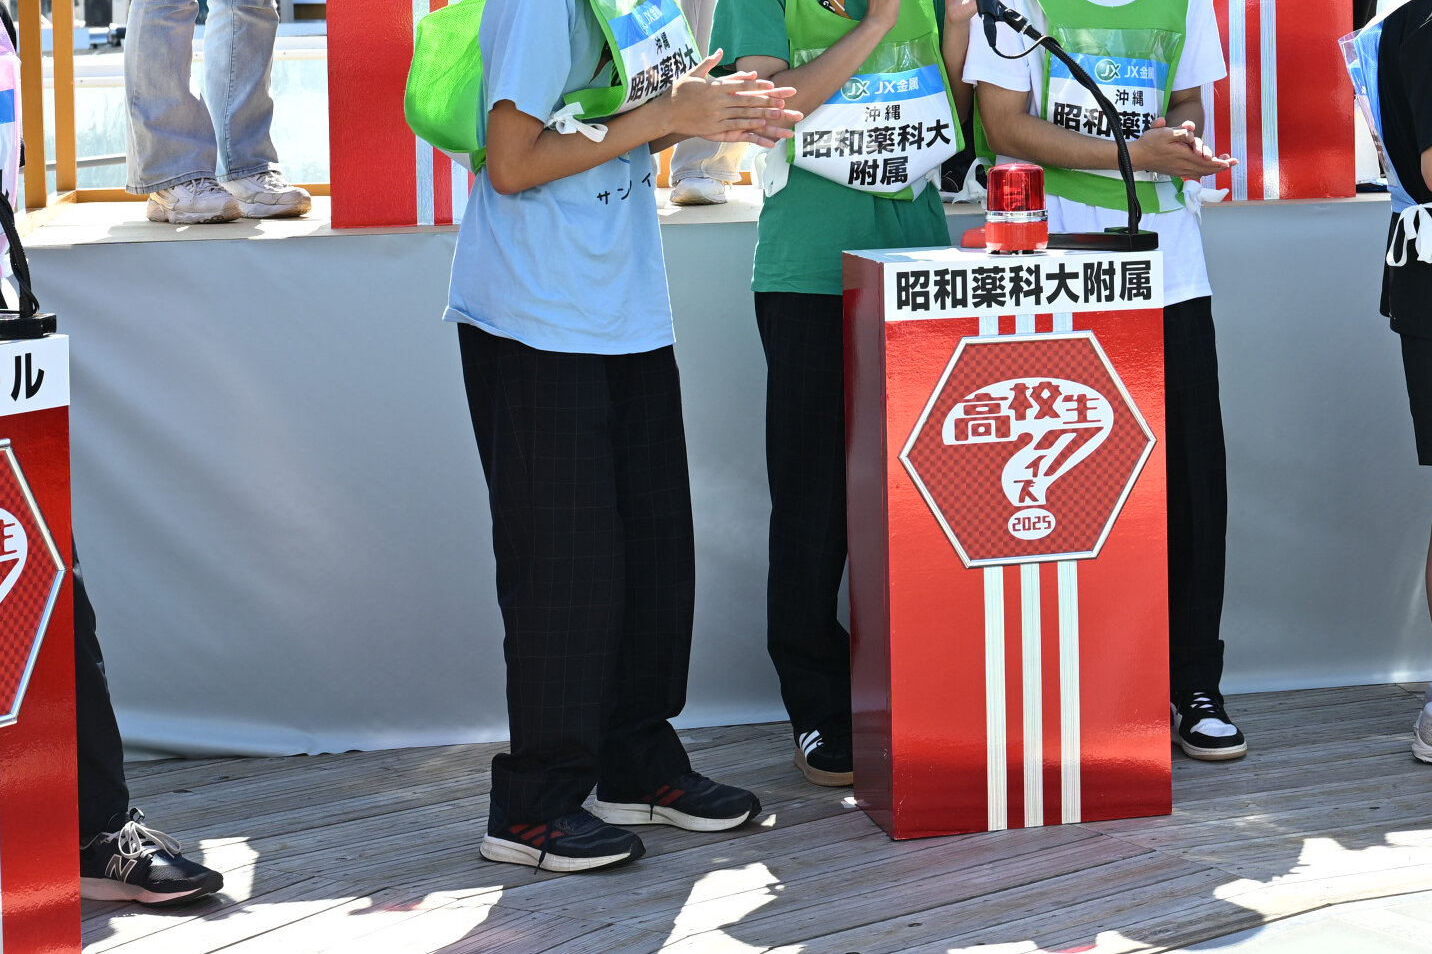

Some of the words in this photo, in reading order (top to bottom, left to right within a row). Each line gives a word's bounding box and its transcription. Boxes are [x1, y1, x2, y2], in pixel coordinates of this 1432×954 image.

[864, 104, 901, 122] 沖縄
[1114, 89, 1144, 107] 沖縄
[802, 119, 951, 158] 昭和薬科大
[847, 156, 909, 186] 附属
[896, 259, 1152, 312] 昭和薬科大附属
[954, 380, 1102, 442] 高校生
[1012, 515, 1052, 532] 2025
